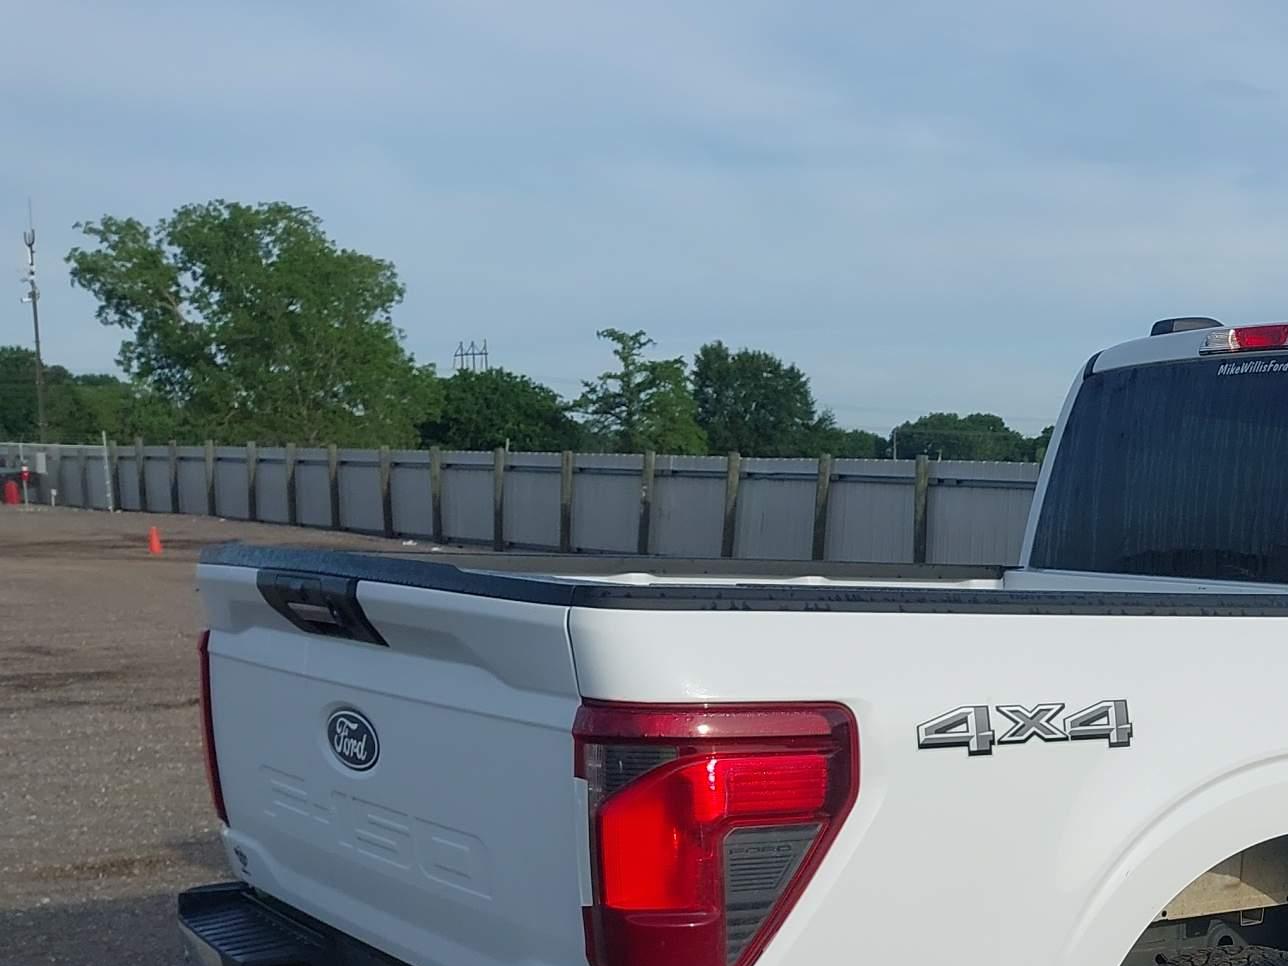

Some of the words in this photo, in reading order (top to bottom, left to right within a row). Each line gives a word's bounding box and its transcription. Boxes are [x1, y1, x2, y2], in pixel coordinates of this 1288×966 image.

[334, 716, 368, 760] Ford
[917, 699, 1133, 756] 4X4
[258, 763, 493, 901] F-150
